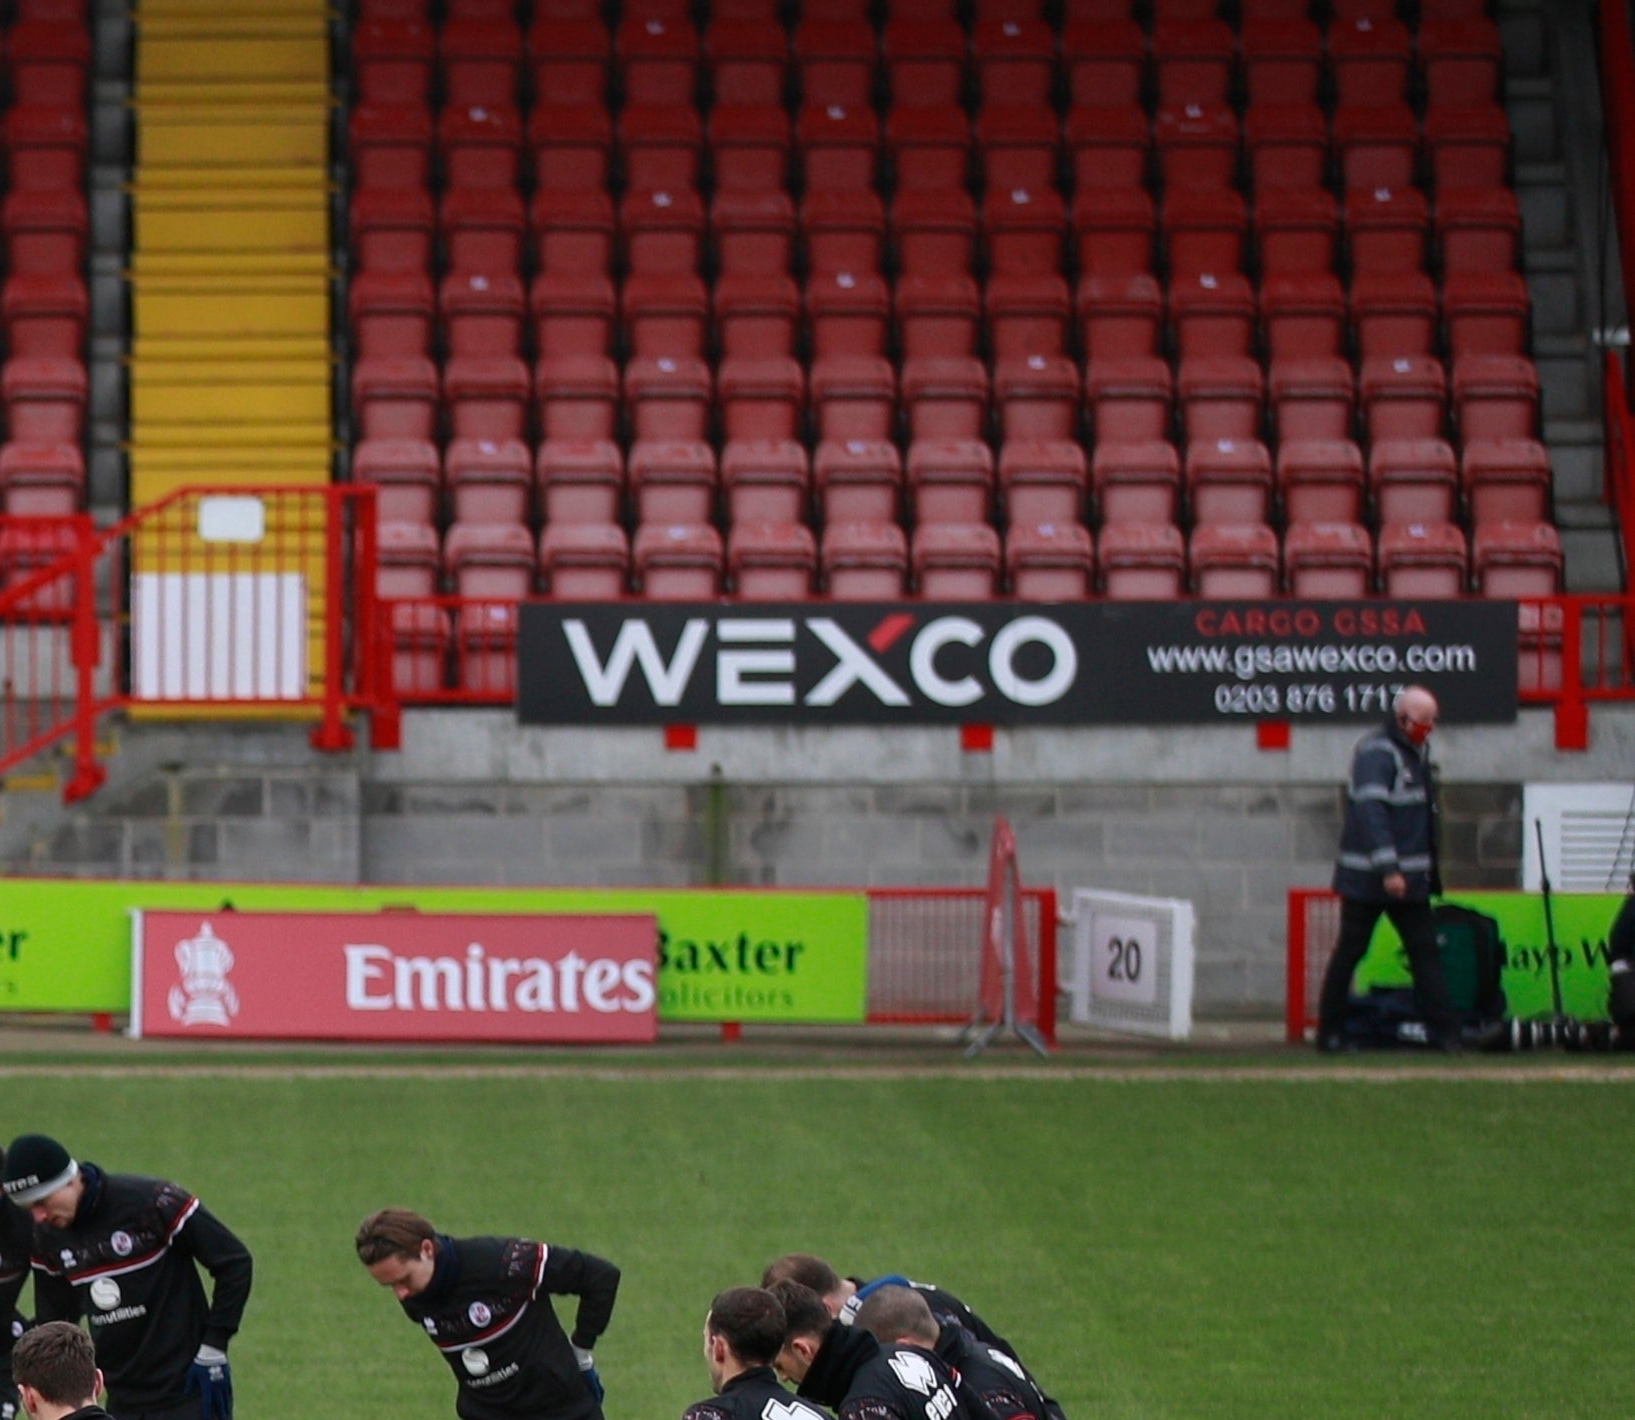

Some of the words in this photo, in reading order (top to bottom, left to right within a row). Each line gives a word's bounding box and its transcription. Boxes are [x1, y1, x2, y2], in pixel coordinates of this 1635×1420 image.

[1194, 608, 1320, 637] CARGO
[1333, 607, 1427, 637] GSSA
[561, 613, 1078, 706] WEXCO
[1146, 644, 1476, 680] www.gsawexco.com
[1214, 684, 1281, 714] 0203
[1286, 684, 1336, 714] 876
[1108, 935, 1142, 983] 20
[343, 941, 656, 1014] Emirates
[660, 980, 795, 1010] olicitors
